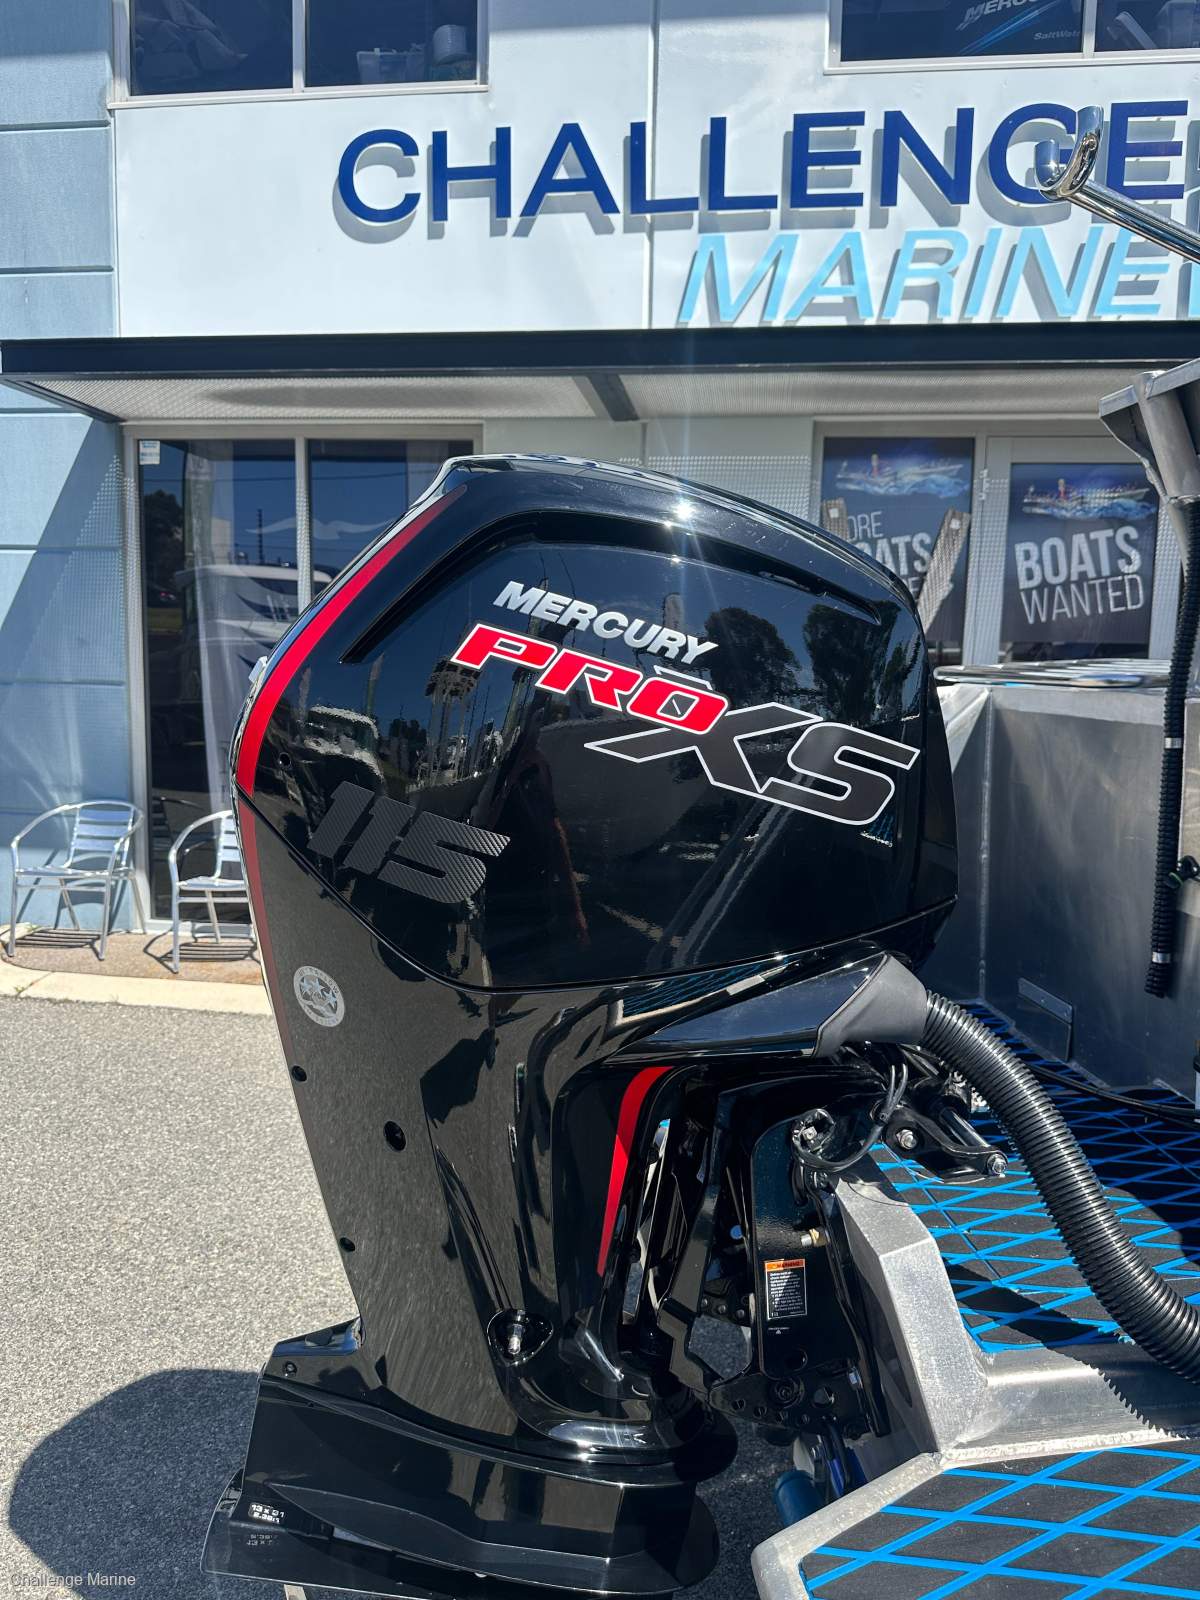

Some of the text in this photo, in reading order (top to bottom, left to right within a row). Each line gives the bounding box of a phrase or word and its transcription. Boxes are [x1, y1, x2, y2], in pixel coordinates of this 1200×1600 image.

[338, 100, 1188, 223] CHALLENGE
[676, 226, 1170, 323] MARINE
[847, 511, 884, 543] ORE
[1014, 525, 1142, 590] BOATS
[493, 581, 719, 665] MERCURY
[1020, 573, 1144, 625] WANTED
[449, 622, 731, 736] PRO
[584, 666, 921, 826] XS
[306, 781, 511, 905] 115
